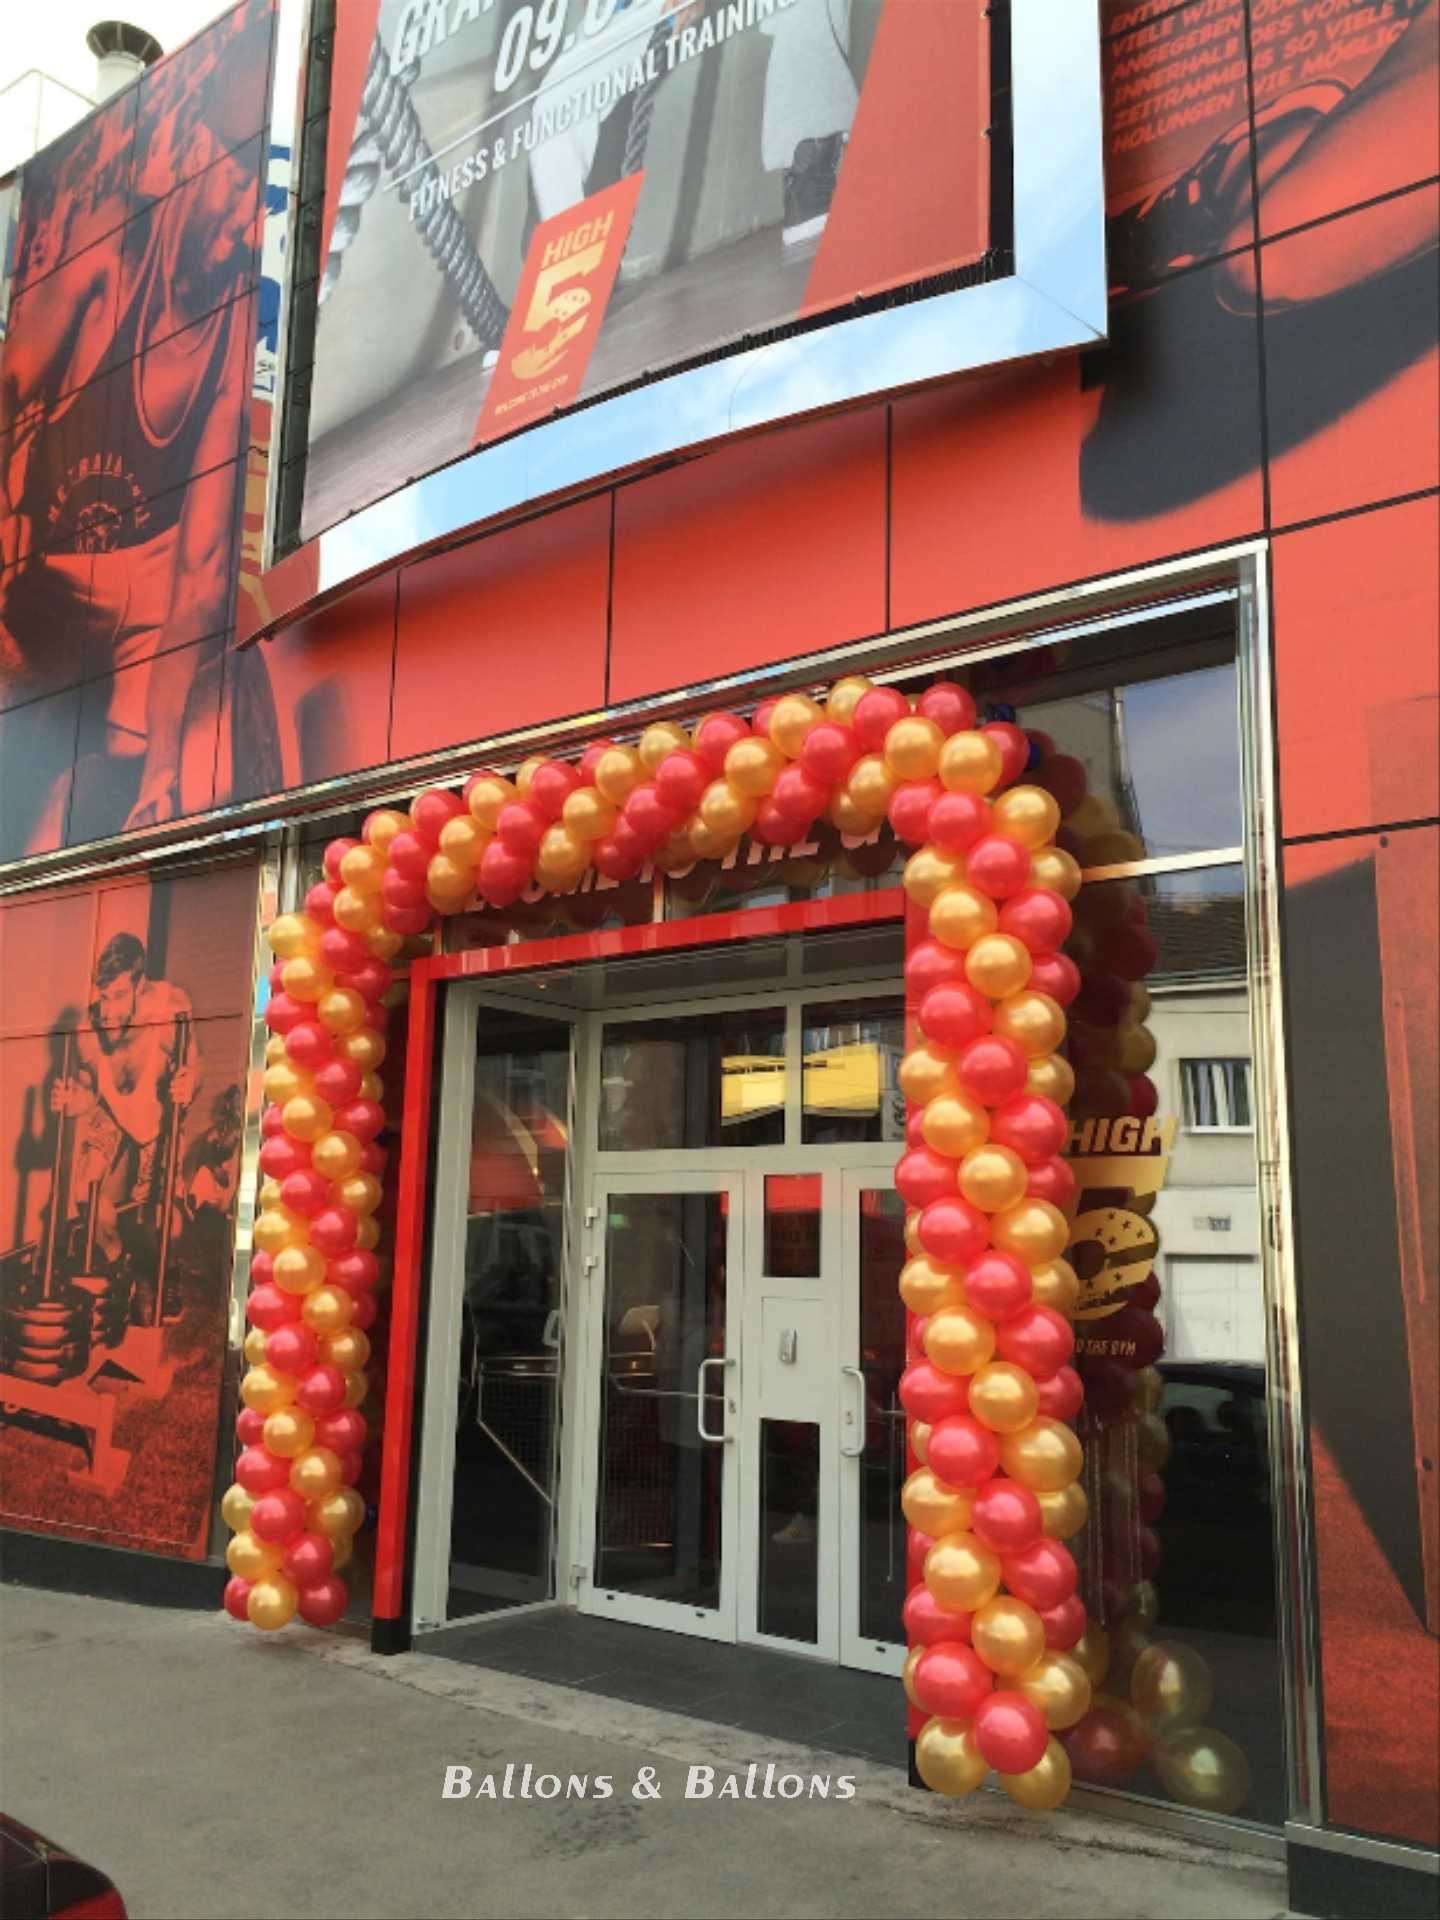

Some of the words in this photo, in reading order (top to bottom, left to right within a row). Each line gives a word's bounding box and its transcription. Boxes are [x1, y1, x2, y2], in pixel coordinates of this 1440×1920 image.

[1251, 14, 1294, 50] DES
[1282, 29, 1318, 60] SO
[408, 148, 490, 222] FITNESS
[492, 137, 507, 170] &
[511, 47, 661, 160] FUNCTIONAL
[664, 0, 797, 71] TRAININ
[541, 209, 616, 269] HIGH
[1067, 1115, 1178, 1152] HIGH
